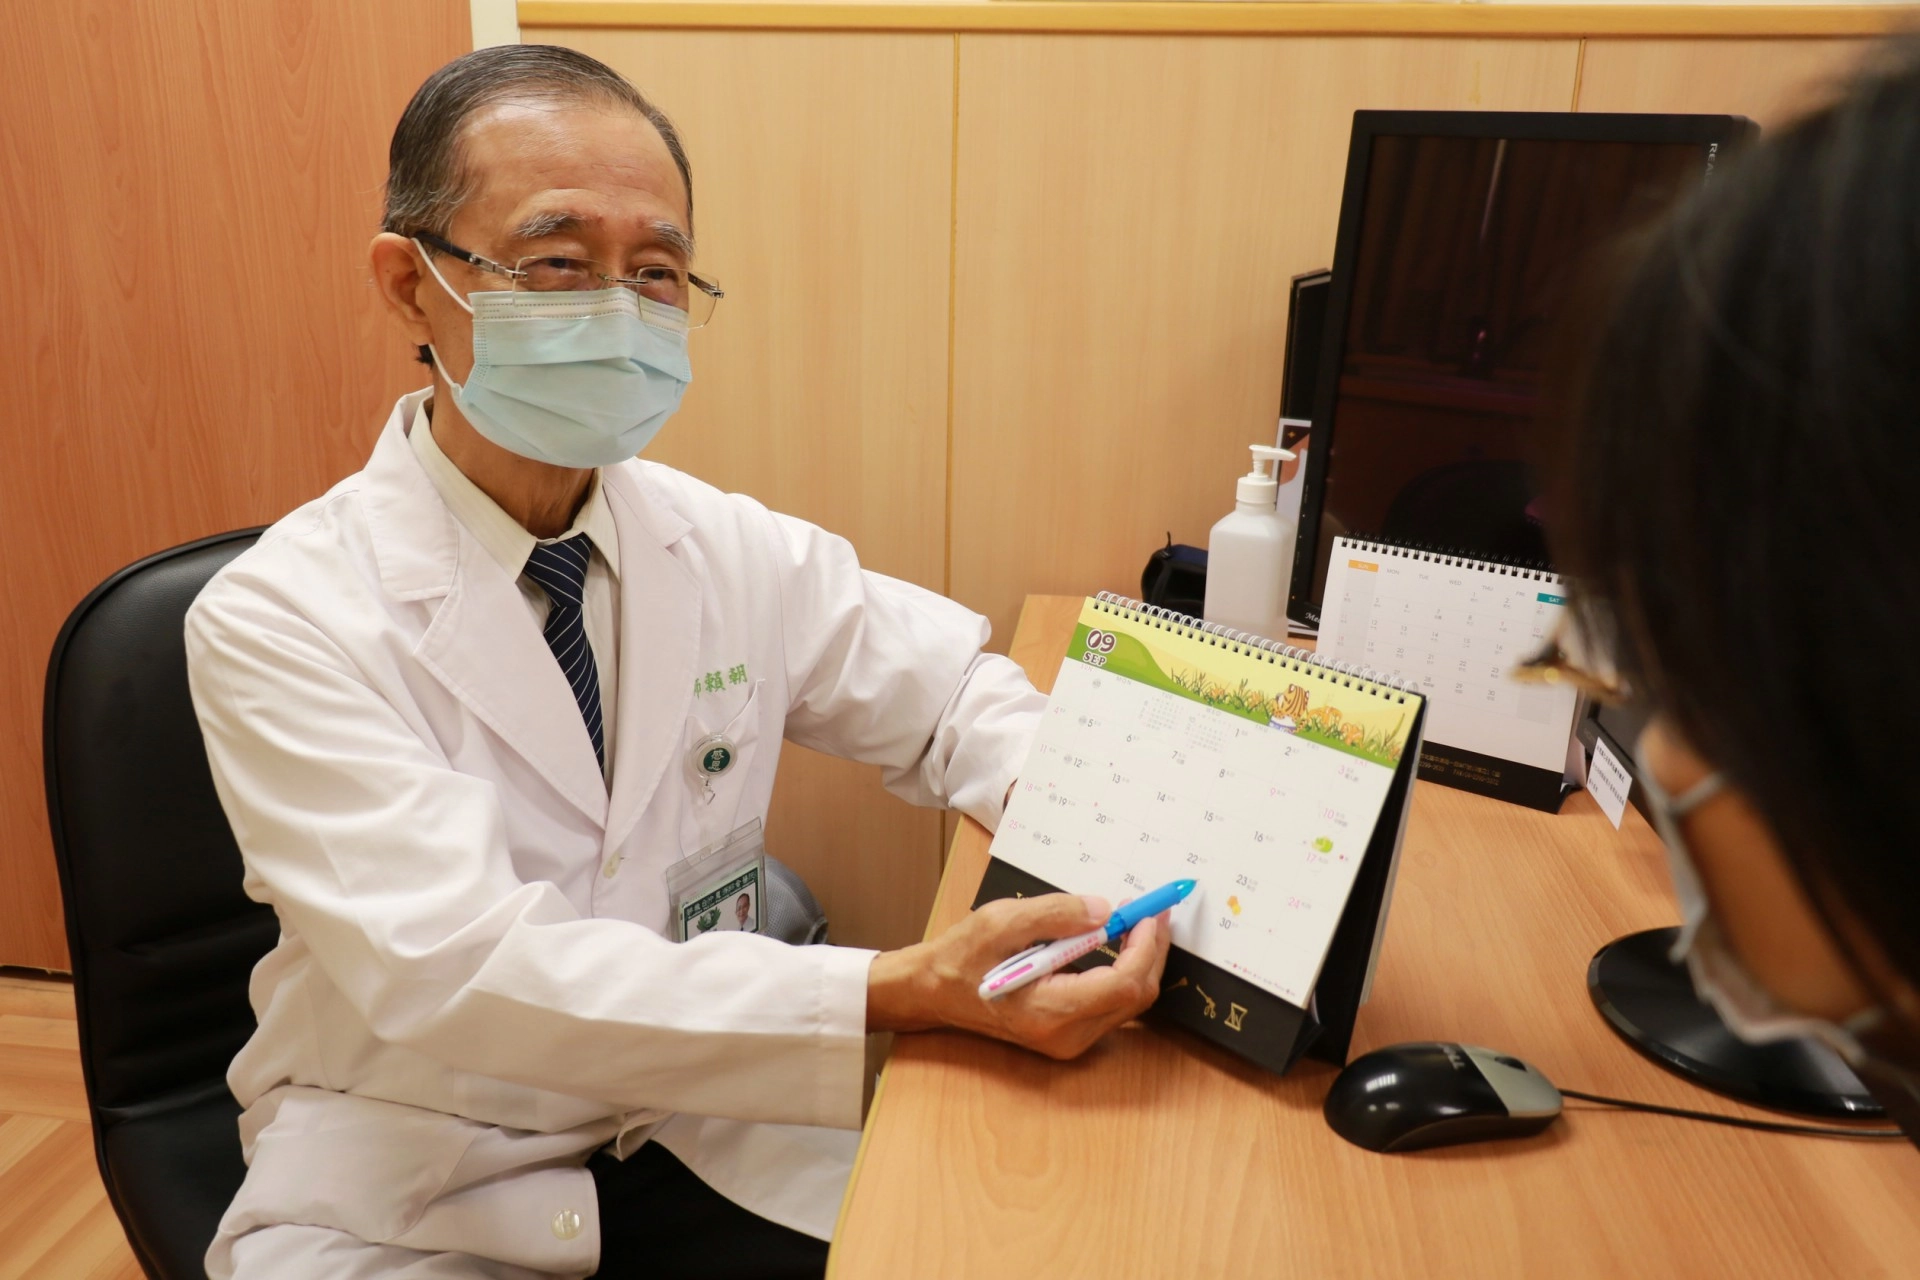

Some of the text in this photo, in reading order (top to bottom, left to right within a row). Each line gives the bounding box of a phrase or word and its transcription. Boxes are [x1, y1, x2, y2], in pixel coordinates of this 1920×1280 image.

[1086, 629, 1116, 653] 09
[1083, 652, 1106, 666] SEP
[1116, 676, 1132, 686] MON
[1087, 718, 1094, 728] 5
[1126, 734, 1132, 743] 6
[1171, 750, 1178, 760] 7
[1219, 768, 1226, 778] 8
[1269, 787, 1277, 798] 9
[1323, 807, 1335, 820] 10
[1284, 746, 1292, 756] 2
[1338, 765, 1345, 775] 3
[1040, 744, 1048, 754] 11
[1073, 757, 1083, 768] 12
[1112, 773, 1121, 784] 13
[1156, 791, 1166, 803] 14
[1204, 810, 1214, 822] 15
[1254, 830, 1264, 843] 16
[1306, 852, 1317, 863] 17
[1008, 819, 1018, 831] 25
[1041, 834, 1051, 846] 26
[1079, 852, 1090, 863] 27
[1123, 873, 1135, 885] 28
[1025, 781, 1034, 792] 18
[1058, 796, 1068, 807] 19
[1095, 813, 1107, 824] 20
[1139, 832, 1150, 843] 21
[1186, 852, 1199, 865] 22
[1236, 873, 1248, 887] 23
[1287, 896, 1301, 909] 24
[1219, 916, 1232, 930] 30
